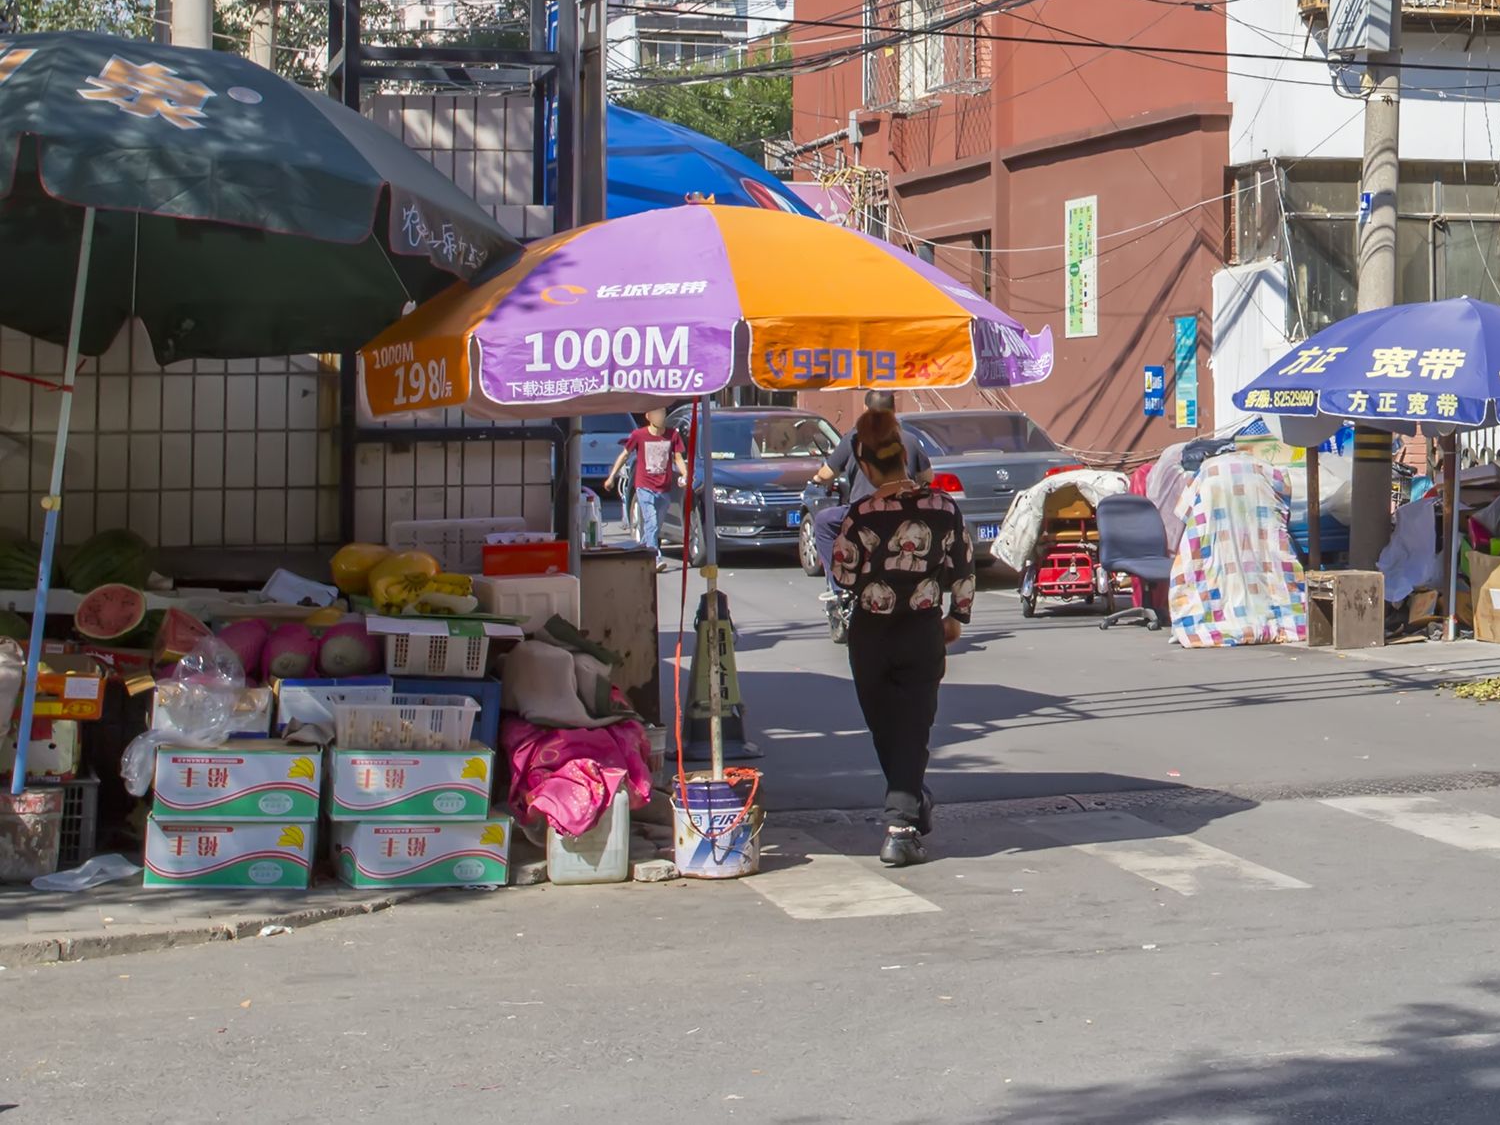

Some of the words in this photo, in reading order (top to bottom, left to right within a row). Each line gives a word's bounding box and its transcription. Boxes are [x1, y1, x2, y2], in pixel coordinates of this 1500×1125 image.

[596, 280, 709, 299] 长城宽带
[372, 341, 414, 370] 1000M
[524, 326, 690, 373] 1000M
[793, 348, 896, 381] 95079
